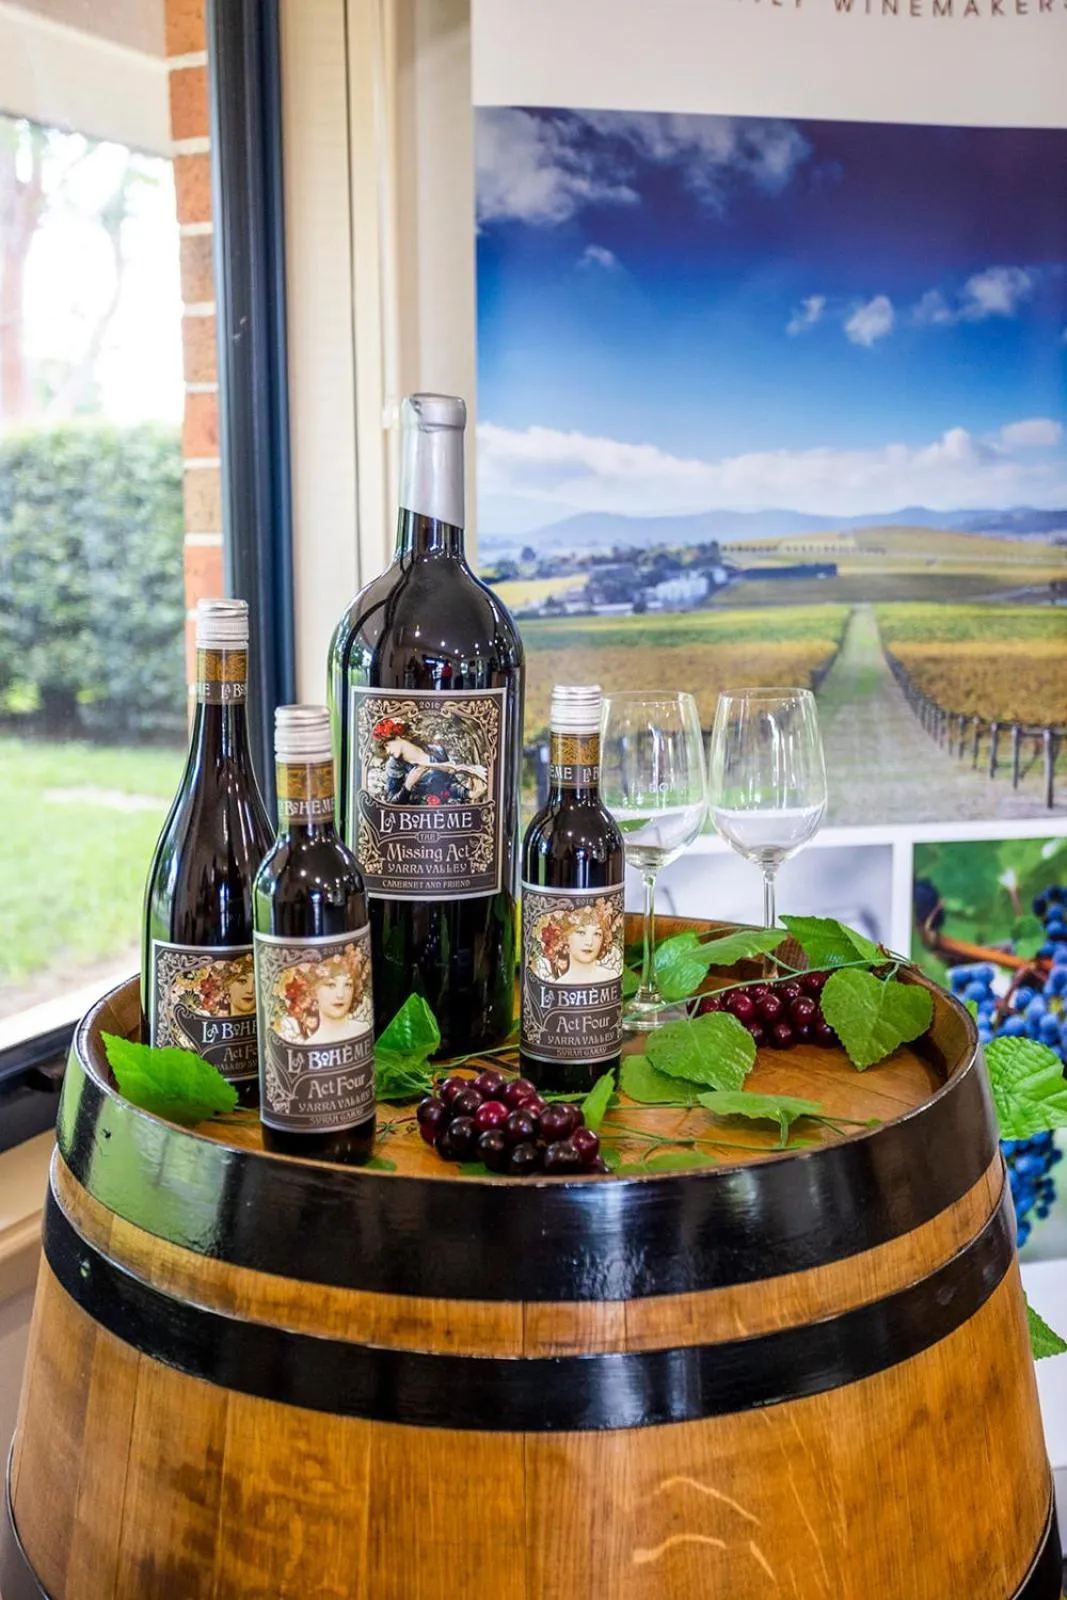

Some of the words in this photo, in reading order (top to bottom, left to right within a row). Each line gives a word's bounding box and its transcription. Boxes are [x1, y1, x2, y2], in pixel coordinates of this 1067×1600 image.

[834, 0, 1067, 17] WINEMAKER
[387, 843, 442, 862] Missing
[446, 843, 470, 861] Act
[387, 864, 424, 874] YARRA
[426, 863, 467, 874] VALLEY
[556, 1016, 580, 1033] Act
[582, 1015, 610, 1033] Four
[547, 1034, 581, 1046] YARRA
[582, 1031, 615, 1045] VALLEY
[308, 1080, 335, 1099] Act
[337, 1074, 366, 1096] Four
[298, 1100, 337, 1113] YARRA
